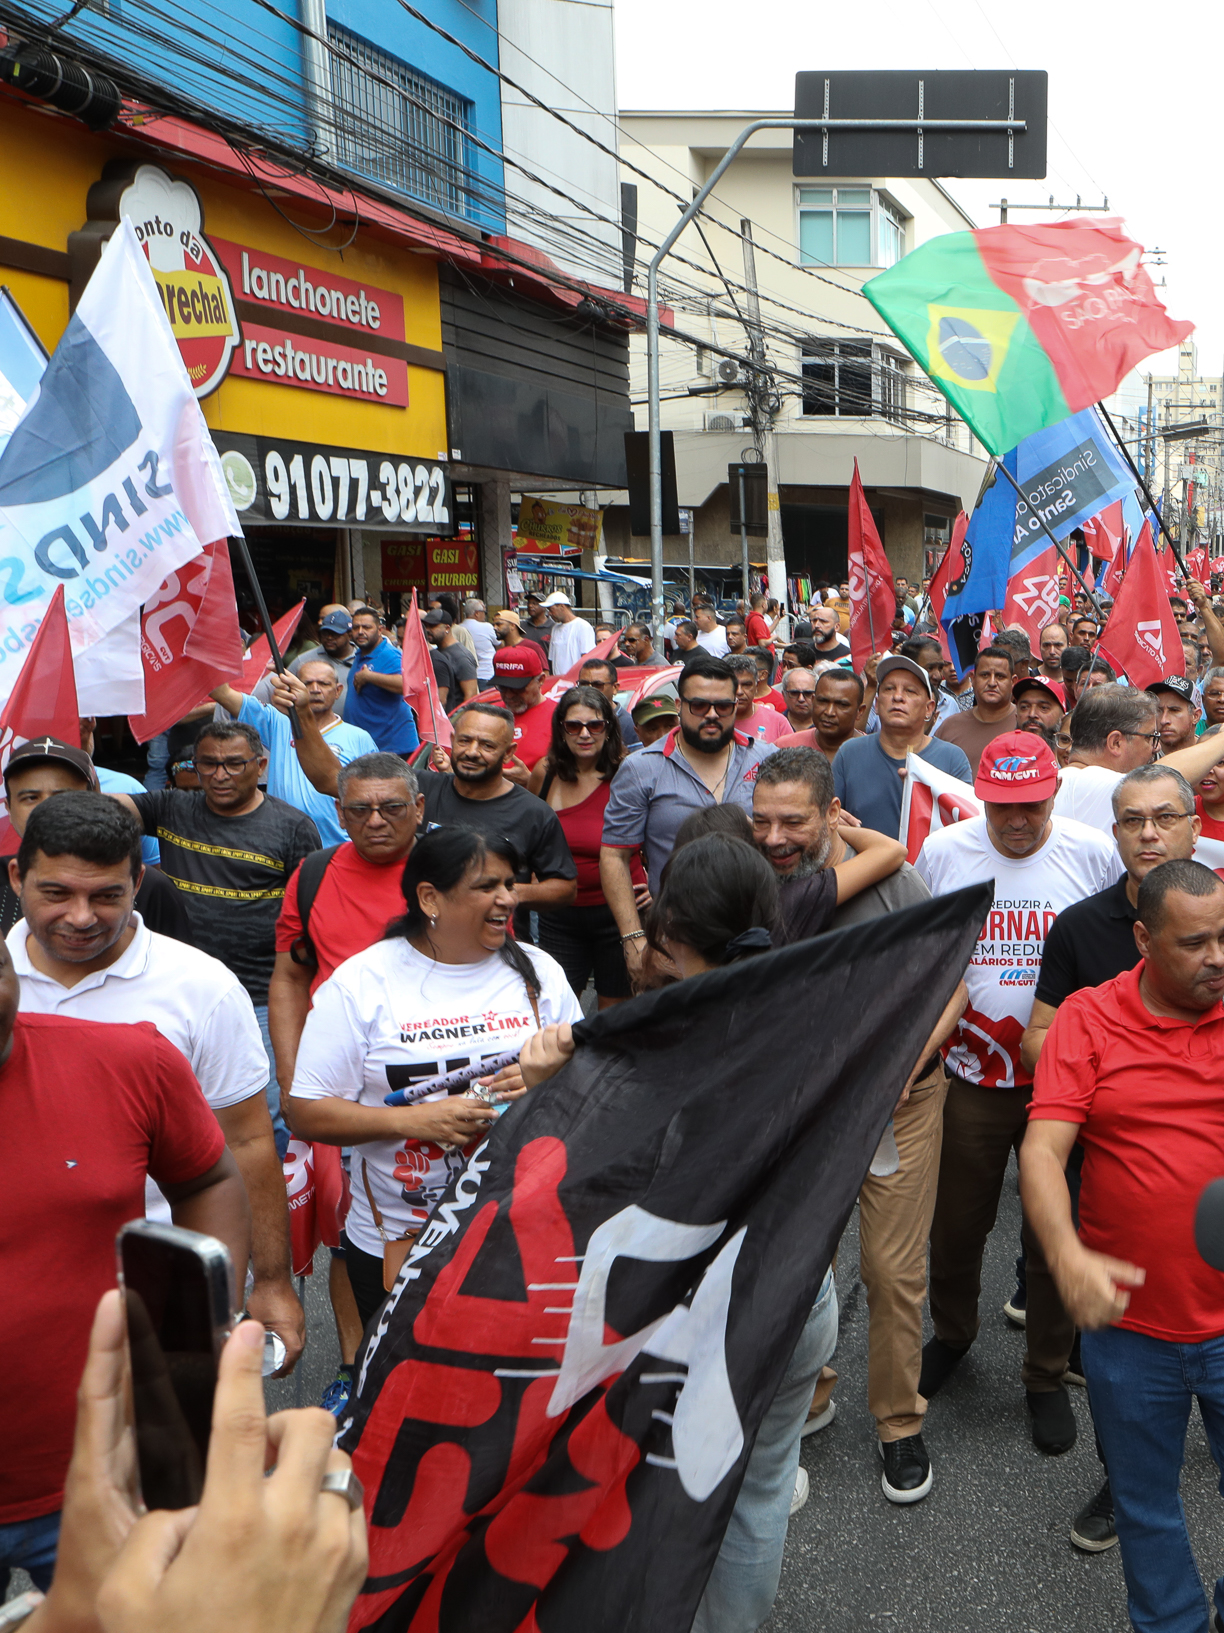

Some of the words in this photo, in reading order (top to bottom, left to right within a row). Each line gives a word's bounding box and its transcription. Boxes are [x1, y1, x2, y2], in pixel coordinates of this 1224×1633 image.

[135, 215, 174, 241] onto
[179, 229, 200, 259] da
[241, 251, 381, 330] lanchonete
[158, 279, 228, 324] arechal
[244, 338, 388, 397] restaurante
[264, 450, 450, 525] 91077-3822
[521, 519, 563, 533] CHURROS
[528, 531, 561, 541] RECHEADOS
[386, 545, 422, 557] GASI
[432, 549, 460, 564] GASI
[384, 578, 426, 586] CHURROS
[430, 572, 478, 587] CHURROS
[990, 900, 1041, 910] REDUZIR
[1044, 901, 1053, 910] A
[974, 943, 998, 957] EM
[1001, 943, 1045, 957] REDU
[967, 956, 1014, 967] ALÁRIOS
[1016, 957, 1023, 967] E
[400, 1015, 470, 1032] VEREADOR
